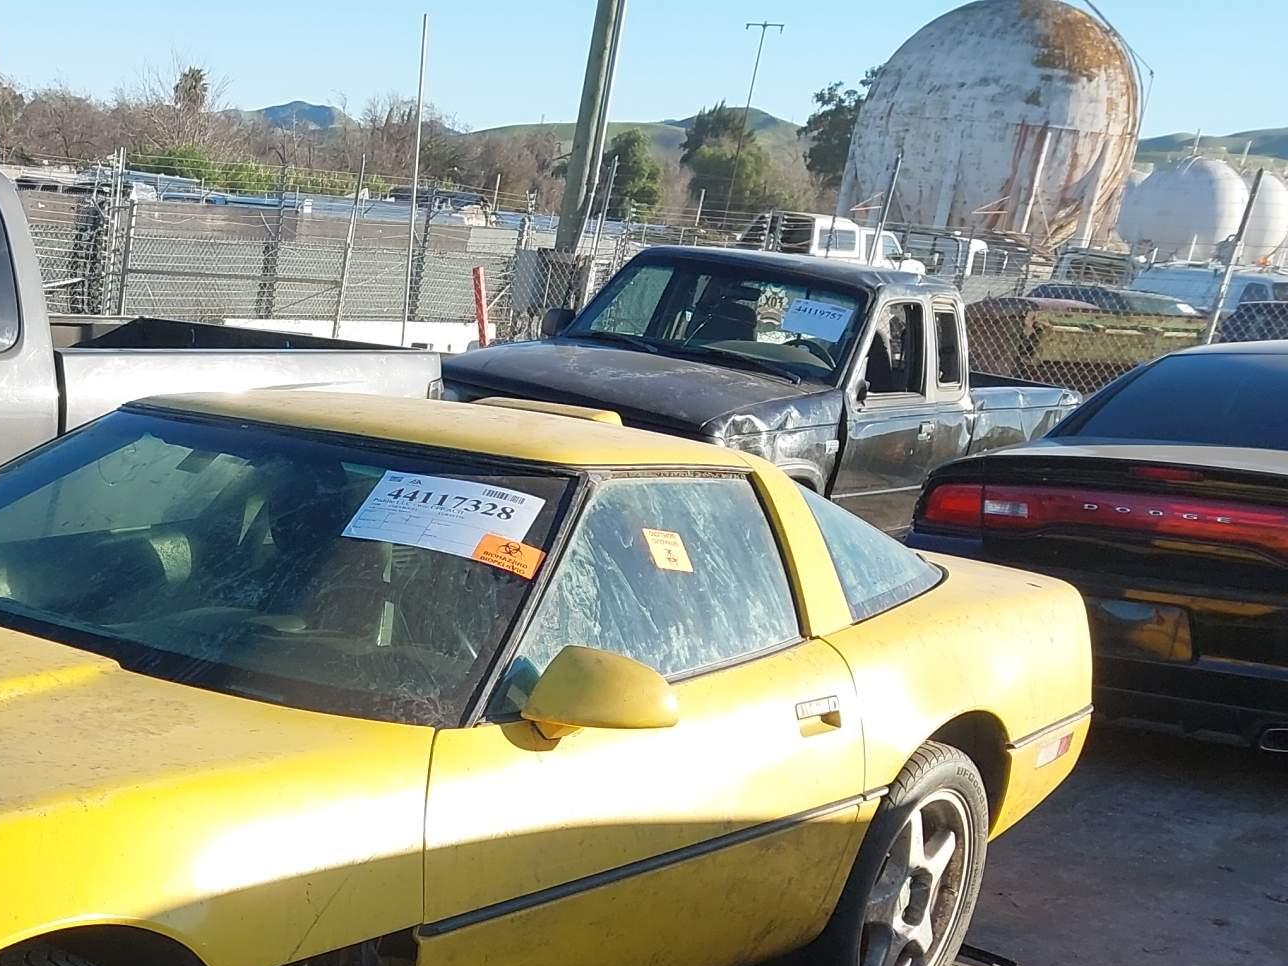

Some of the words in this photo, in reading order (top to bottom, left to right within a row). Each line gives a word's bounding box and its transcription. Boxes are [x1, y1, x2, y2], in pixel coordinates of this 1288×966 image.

[795, 306, 844, 321] 44119757
[388, 487, 515, 521] 44117328
[1083, 503, 1231, 523] DODGE
